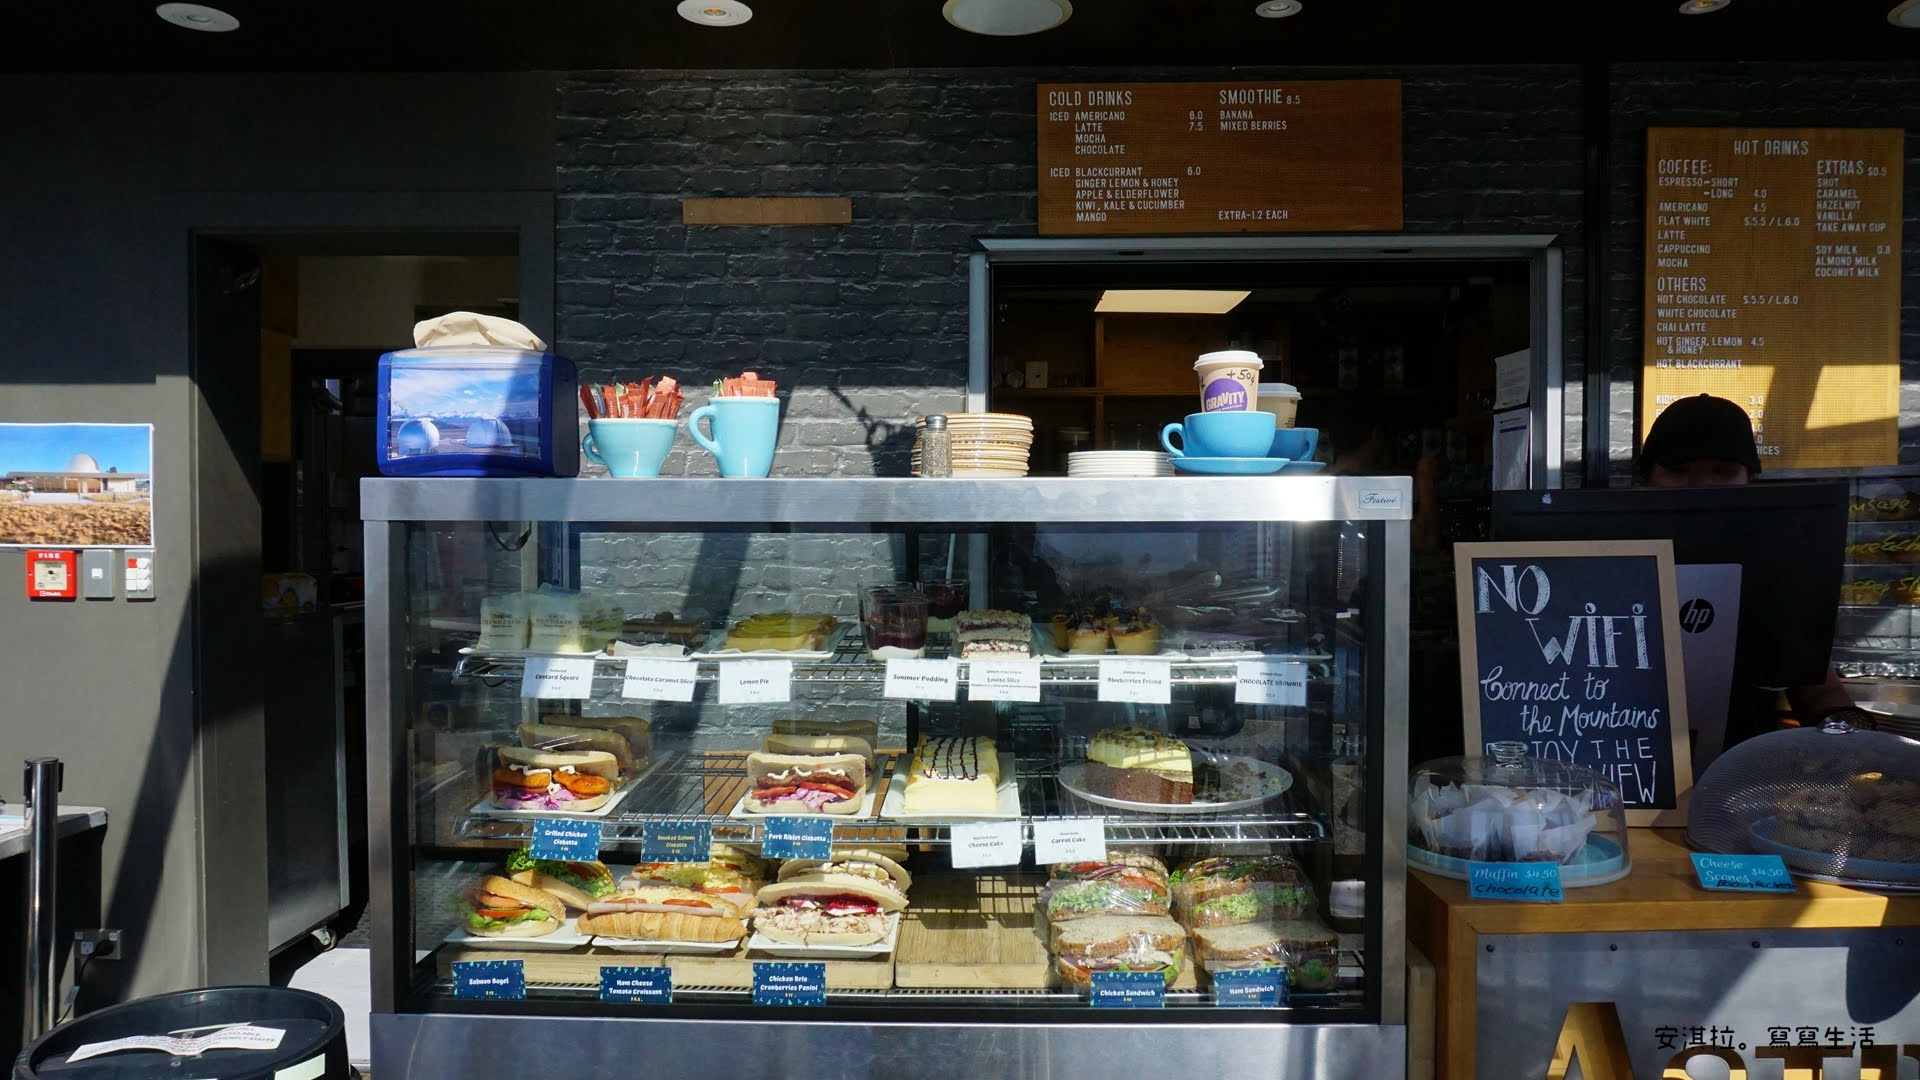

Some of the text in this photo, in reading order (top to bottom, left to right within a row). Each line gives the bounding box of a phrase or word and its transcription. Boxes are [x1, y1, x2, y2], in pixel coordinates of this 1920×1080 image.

[1049, 90, 1133, 107] COLD DRINKS
[1219, 89, 1301, 105] SMOOTHIE 8.5
[1049, 110, 1203, 122] ICED AMERICANO 6.0
[1219, 110, 1253, 120] BANANA
[1074, 121, 1203, 133] LATTE 7.5
[1220, 121, 1287, 131] MIXED BERRIES
[1075, 133, 1106, 144] MOCHA
[1075, 145, 1126, 155] CHOCOLATE
[1733, 140, 1809, 155] HOT DRINKS
[1658, 159, 1712, 174] COFFEE:
[1816, 160, 1864, 176] EXTRAS
[1050, 166, 1201, 178] ICED BLACKCURRANT 6.0
[1075, 177, 1179, 188] GINGER LEMON & HONEY
[1817, 178, 1839, 187] SHOT
[1075, 188, 1180, 200] APPLE & ELDERFLOWER
[1753, 189, 1767, 198] 4.0
[1816, 189, 1858, 199] CARAMEL
[1103, 200, 1127, 211] KALE
[1128, 200, 1135, 210] &
[1136, 200, 1185, 210] CUCUMBER
[1658, 202, 1767, 212] AMERICANO 4.5
[1816, 200, 1861, 210] HAZELNUT
[1076, 212, 1107, 222] MANGO
[1265, 210, 1288, 220] EACH
[1816, 212, 1853, 221] VANILLA
[1658, 216, 1681, 226] FLAT
[1683, 216, 1711, 226] WHITE
[1816, 223, 1887, 233] TAKE AWAY CUP
[1657, 230, 1686, 240] LATTE
[1657, 244, 1711, 254] CAPPUCCINO
[1815, 245, 1891, 255] SOY MILK 0.8
[1657, 258, 1688, 268] MOCHA
[1815, 256, 1877, 266] ALMOND MILK
[1815, 267, 1880, 277] COCONUT MILK
[1657, 277, 1706, 292] OTHERS
[1657, 295, 1674, 304] HOT
[1676, 295, 1727, 304] CHOCOLATE
[1657, 308, 1737, 319] WHITE CHOCOLATE
[1656, 322, 1706, 332] CHAI LATTE
[1656, 337, 1674, 346] HOT
[1711, 337, 1743, 346] LEMON
[1750, 337, 1765, 346] 4.5
[1667, 345, 1703, 354] & HONEY
[1656, 359, 1742, 369] HOT BLACKCURRANT
[1205, 390, 1246, 412] GRAVITY
[1749, 395, 1764, 405] 3.0
[1749, 409, 1764, 419] 2.0
[1477, 564, 1551, 615] NO
[1682, 598, 1711, 633] hp
[625, 674, 654, 682] Chocolate
[893, 673, 920, 681] Summer
[1240, 678, 1303, 688] CHOCOLATE BROWNIE
[1480, 665, 1610, 701] Connect to
[1520, 702, 1660, 737] the Mountains
[1590, 737, 1653, 759] THE
[564, 830, 588, 838] Chicken
[783, 833, 801, 841] Riblet
[553, 838, 578, 846] Ciabatta
[1700, 857, 1744, 870] Cheese
[1474, 867, 1518, 882] Muffin
[1705, 870, 1750, 883] Scones
[491, 977, 509, 985] Bagel
[608, 987, 632, 995] Tomato
[1244, 985, 1274, 994] Sandwich
